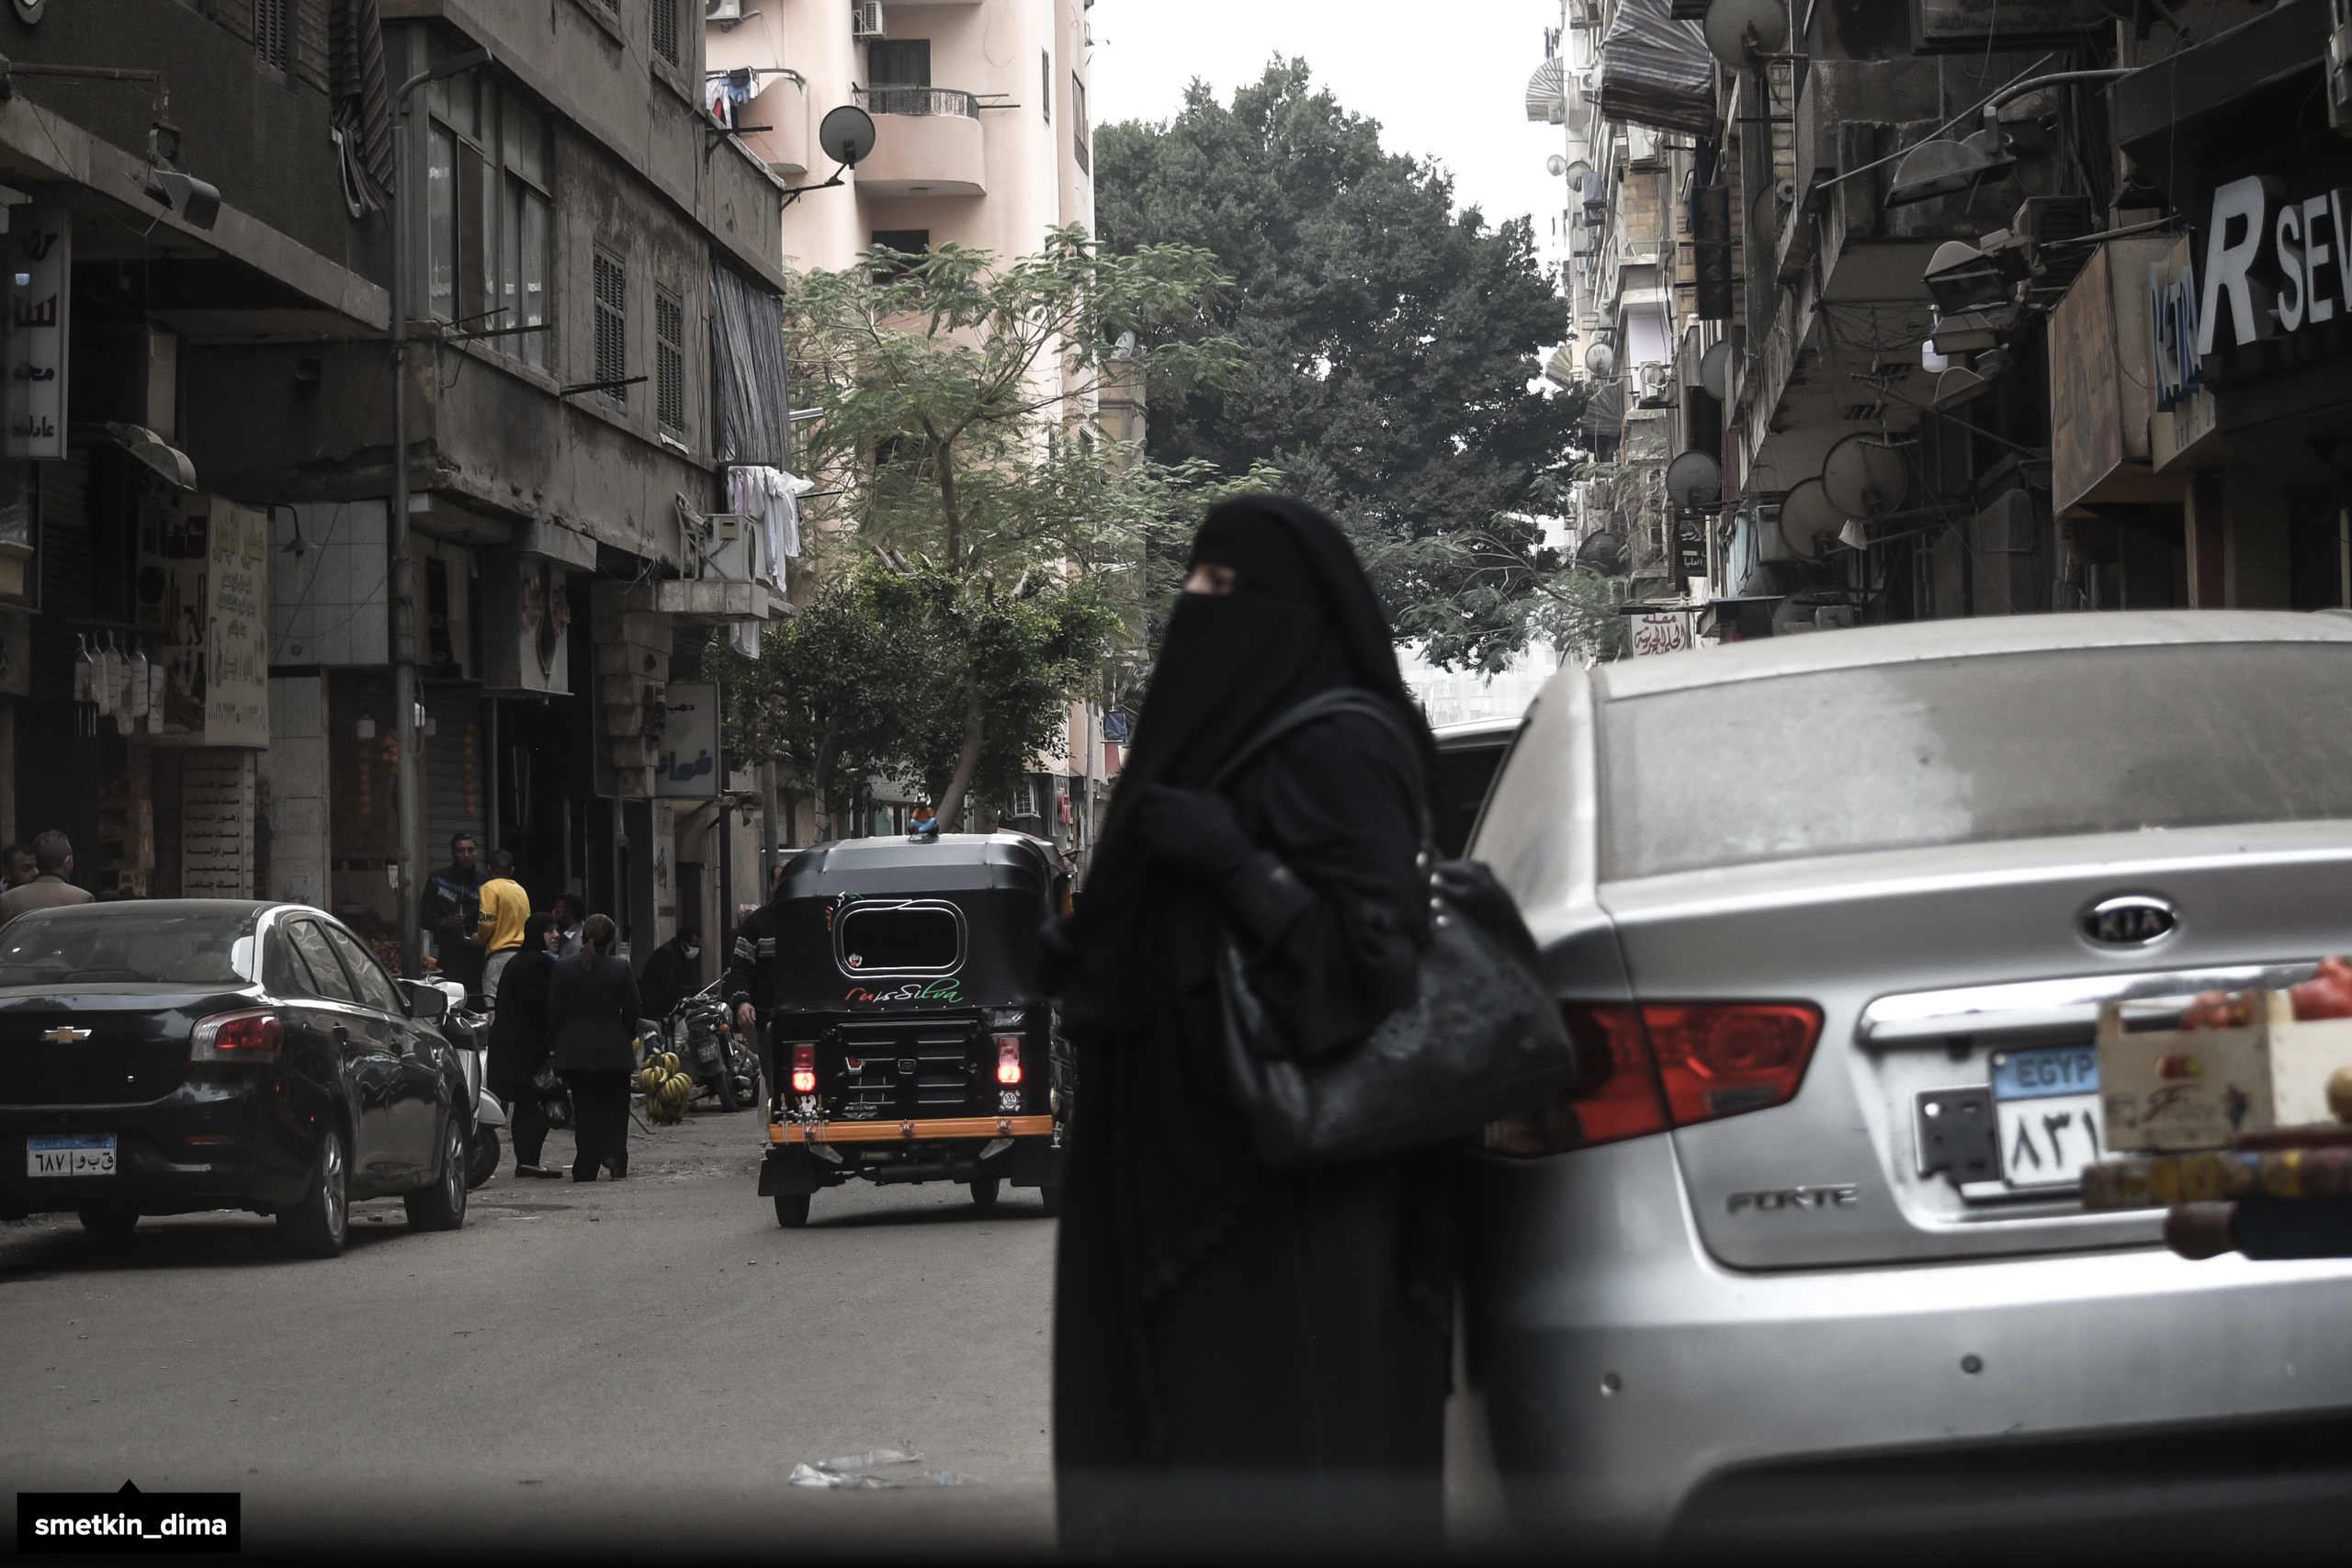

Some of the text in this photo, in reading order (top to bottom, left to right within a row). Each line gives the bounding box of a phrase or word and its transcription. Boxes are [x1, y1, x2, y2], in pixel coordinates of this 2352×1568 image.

[2198, 175, 2271, 356] R
[667, 702, 695, 715] دهب
[217, 812, 241, 824] زهور
[214, 829, 240, 838] مسك
[216, 879, 240, 889] مسك
[2015, 1054, 2098, 1089] EGYP
